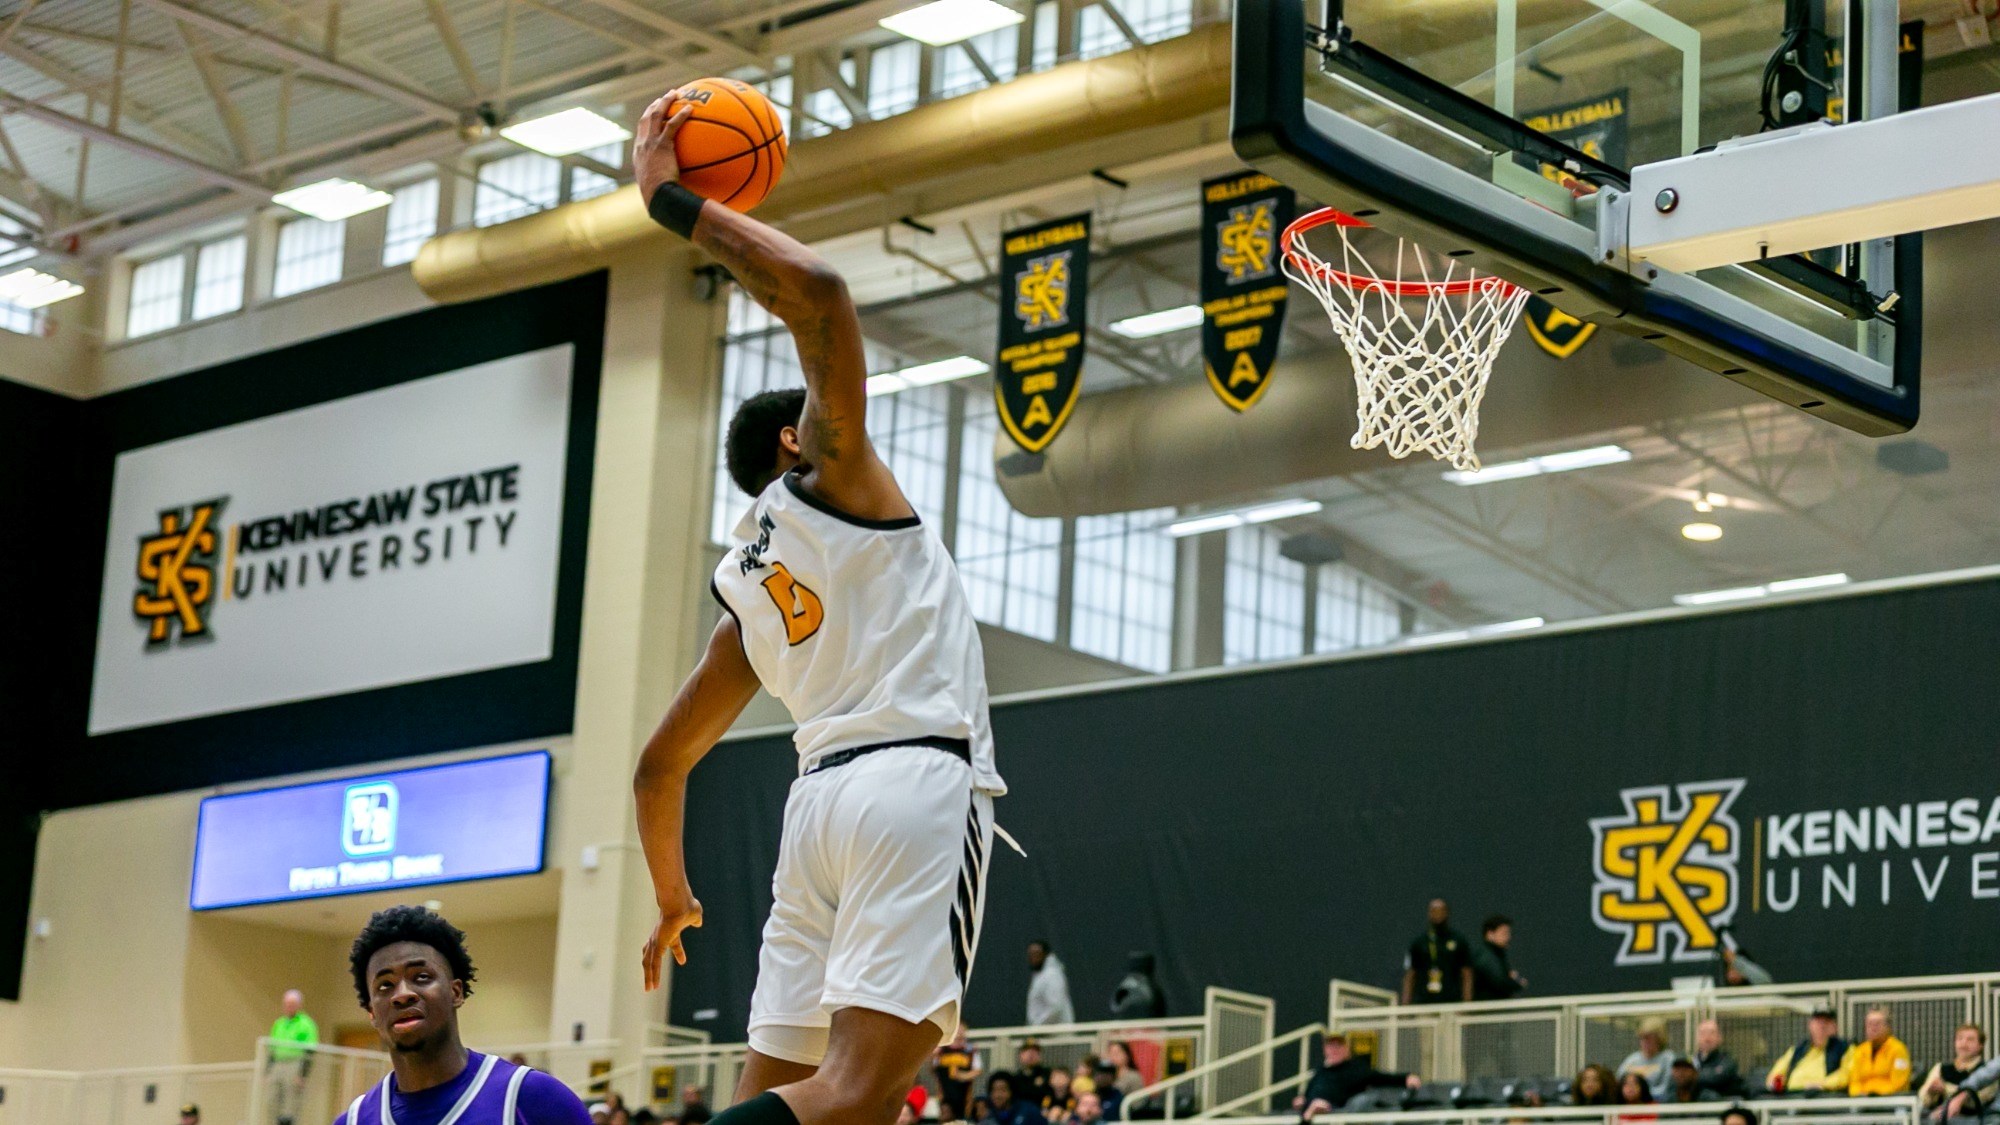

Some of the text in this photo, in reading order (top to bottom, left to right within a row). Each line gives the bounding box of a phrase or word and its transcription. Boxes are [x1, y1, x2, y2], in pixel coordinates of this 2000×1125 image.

[237, 463, 521, 554] KENNESAW STATE
[233, 510, 518, 599] UNIVERSITY
[1766, 851, 2000, 912] UNIVE
